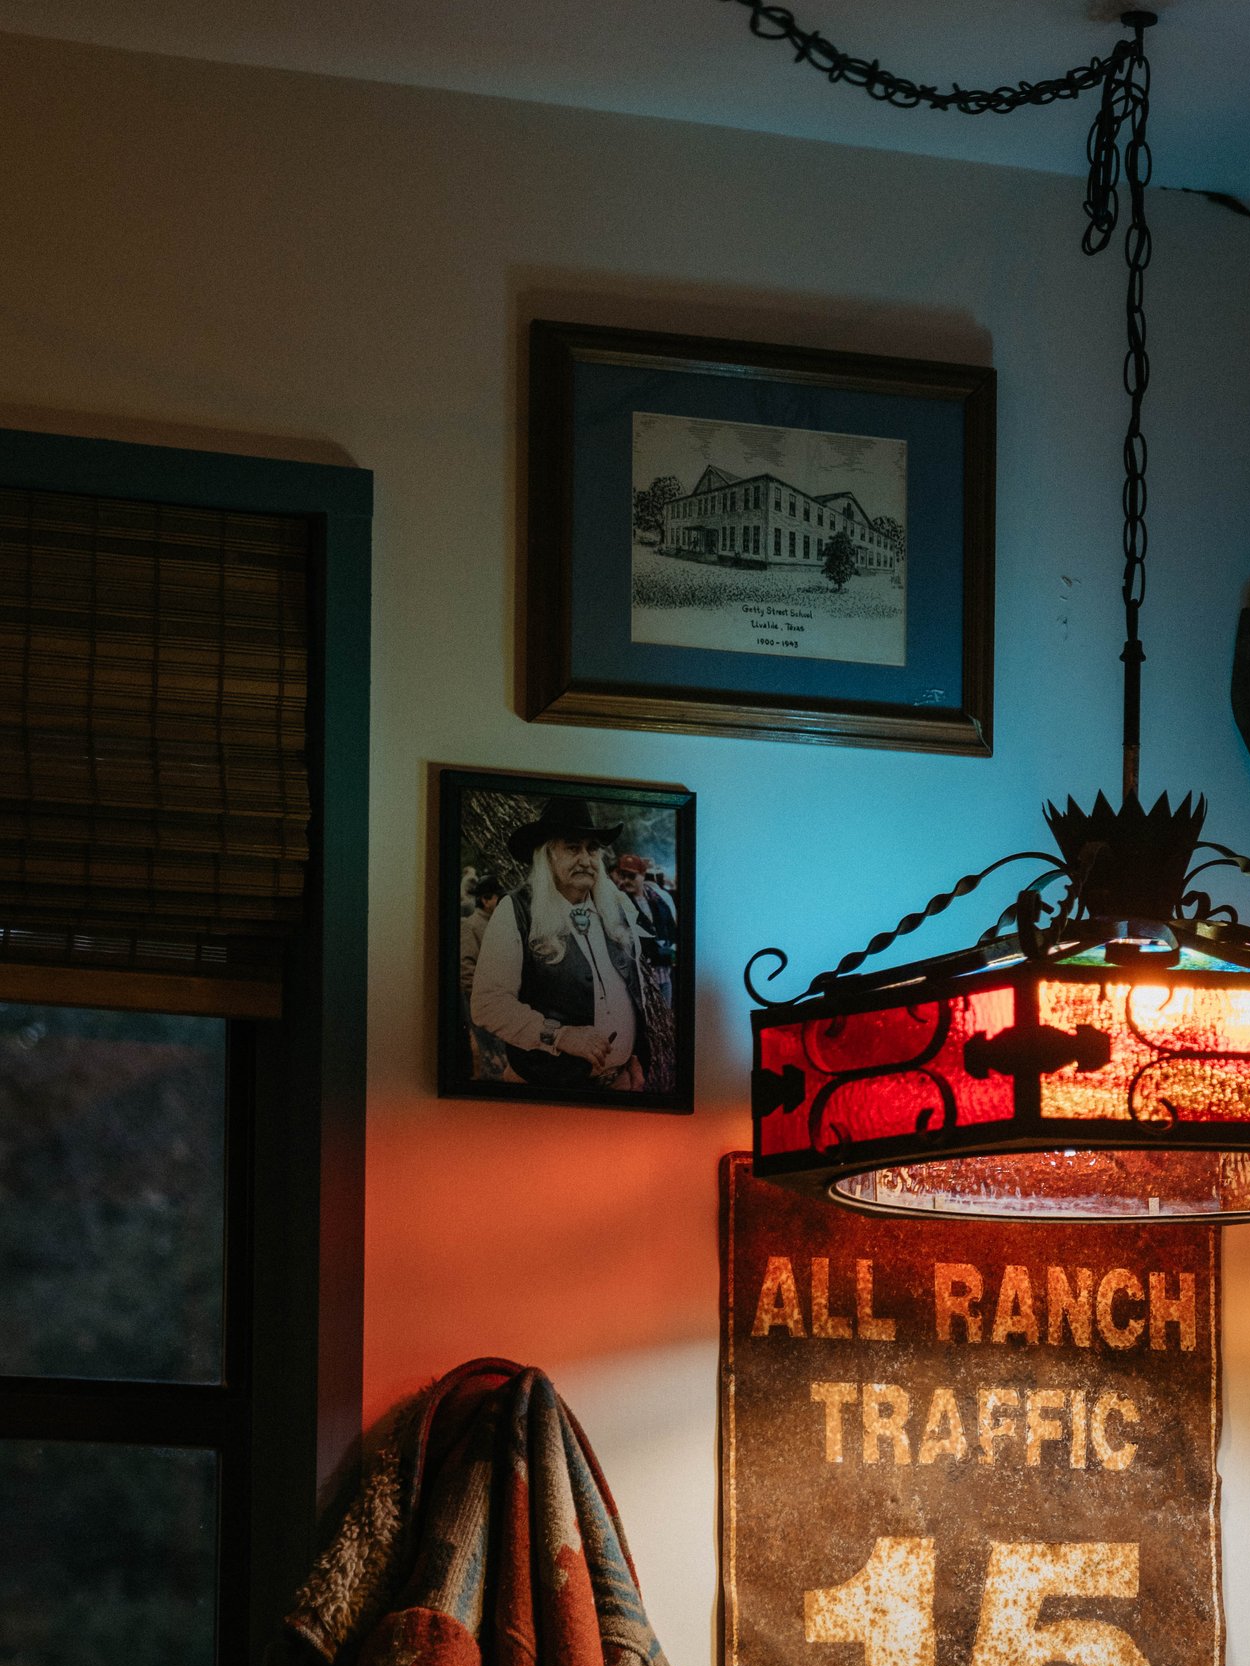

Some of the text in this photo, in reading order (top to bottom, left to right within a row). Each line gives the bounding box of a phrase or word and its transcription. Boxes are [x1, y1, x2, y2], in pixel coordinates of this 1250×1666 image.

[751, 1256, 1198, 1351] ALL RANCH
[809, 1382, 1139, 1470] TRAFFIC
